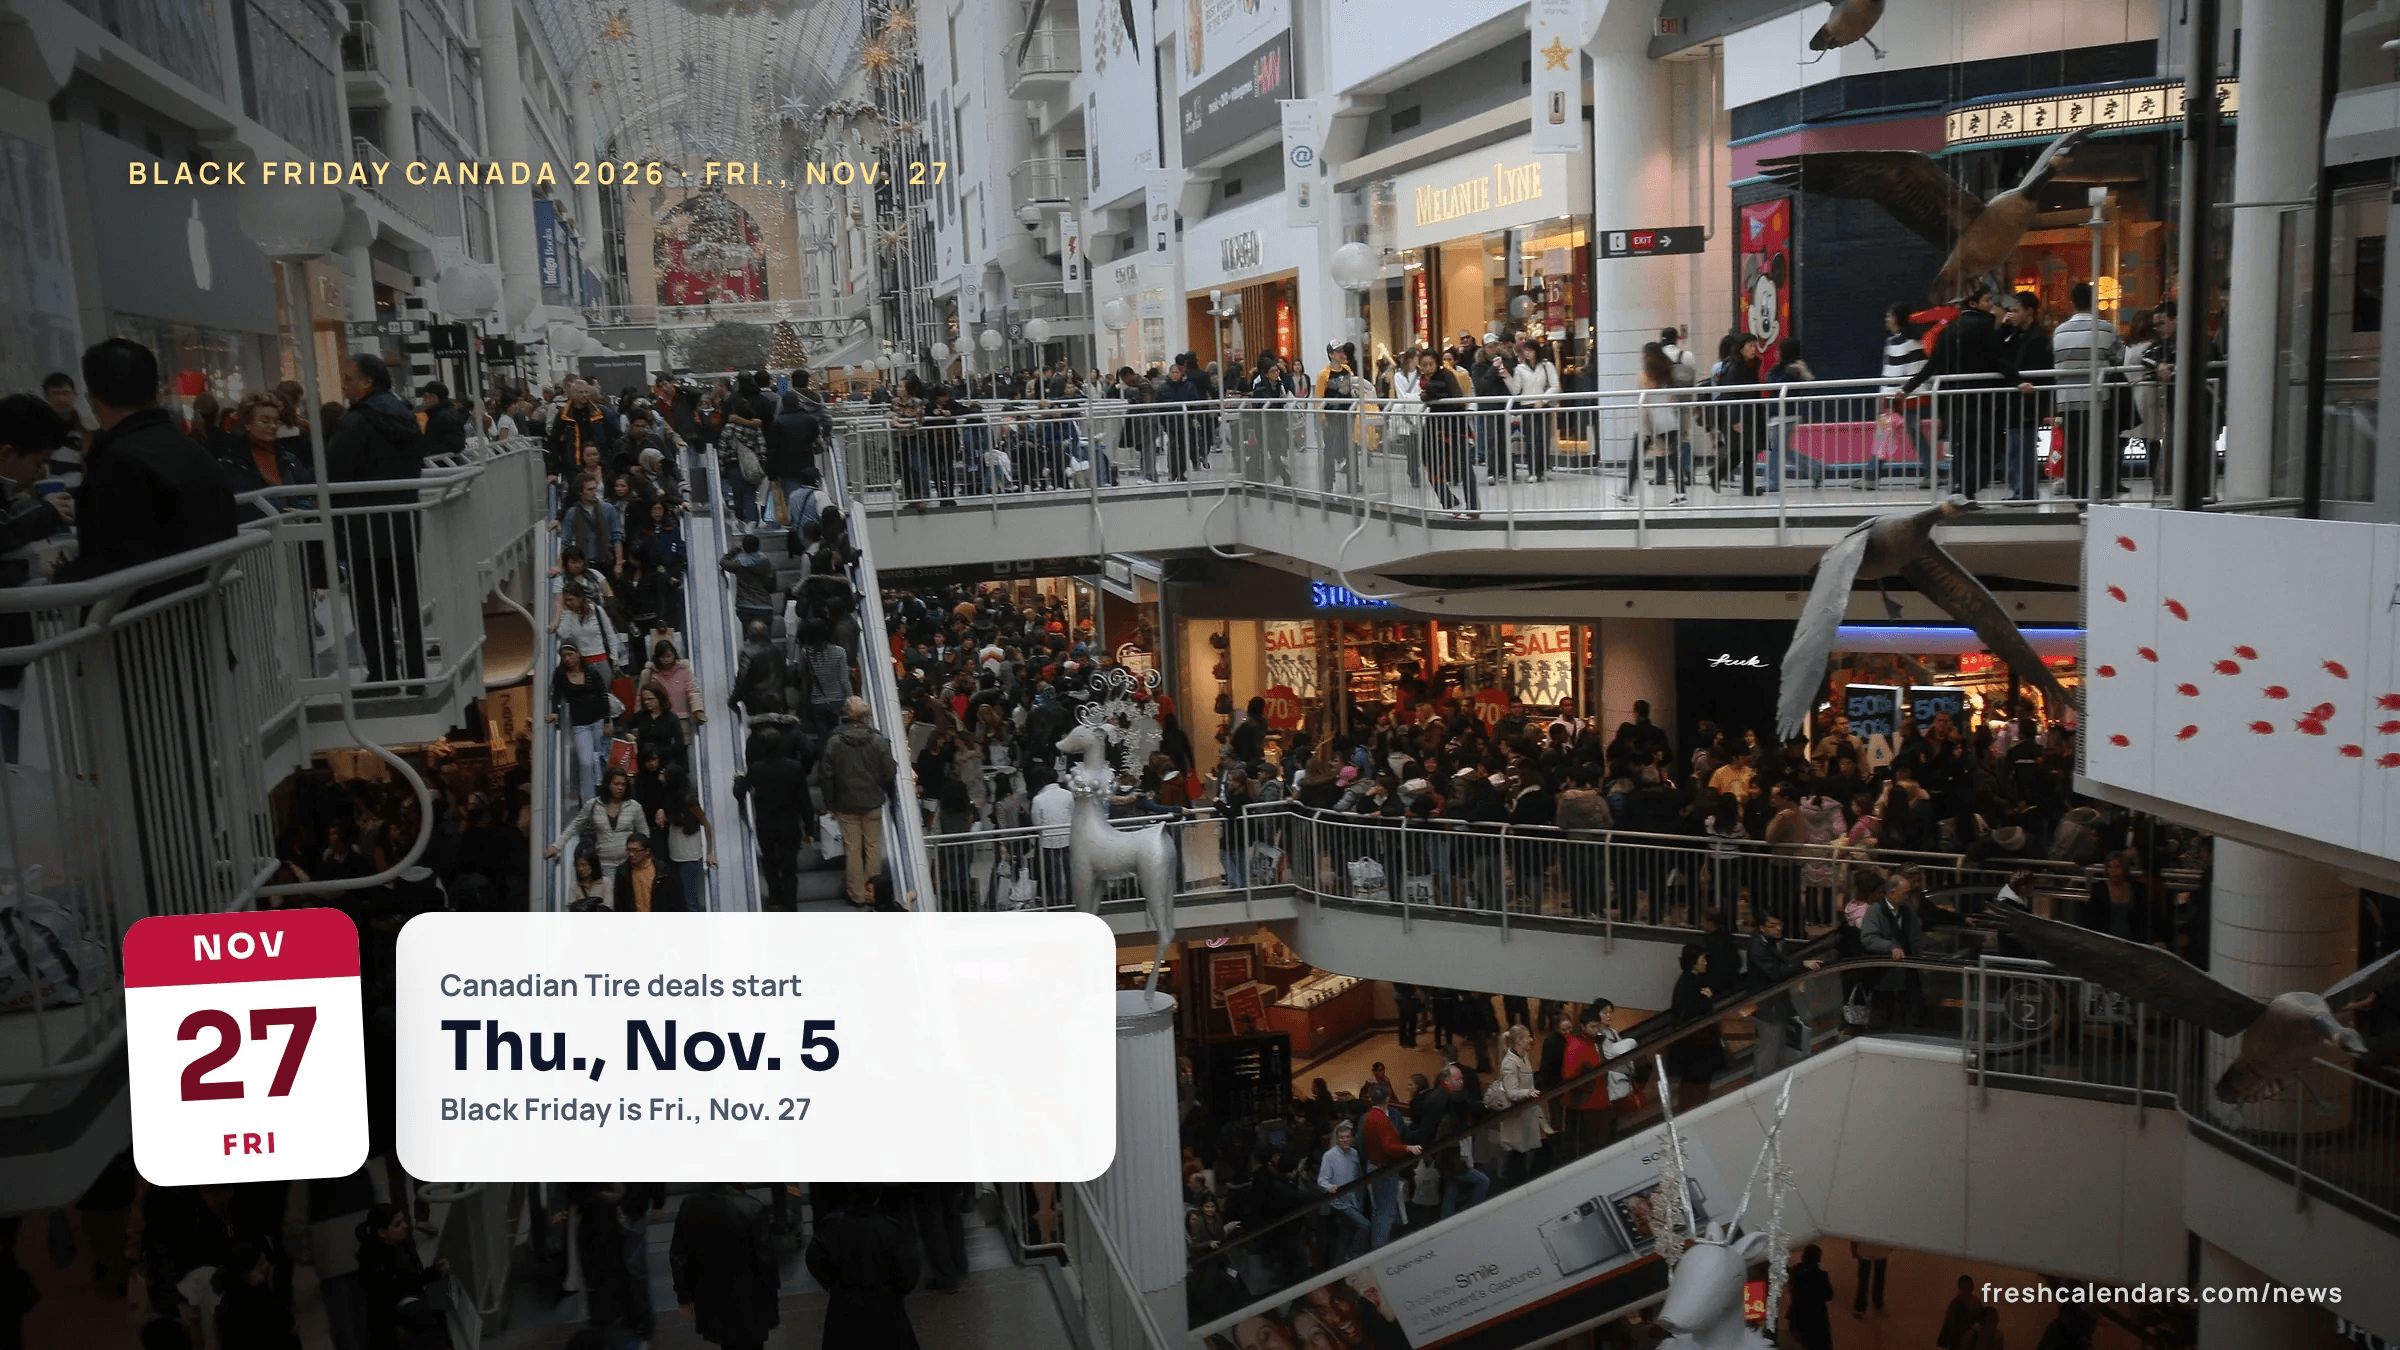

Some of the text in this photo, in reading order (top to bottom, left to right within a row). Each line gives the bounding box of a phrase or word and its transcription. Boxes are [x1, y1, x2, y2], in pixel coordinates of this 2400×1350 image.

[1415, 161, 1543, 227] MELANIE LYNE
[1633, 235, 1653, 246] EXIT
[542, 228, 558, 284] Indigo Books
[878, 569, 915, 579] undas
[1264, 627, 1319, 651] SALE
[1513, 630, 1572, 656] SALE
[2021, 1003, 2037, 1023] 2
[1454, 1262, 1500, 1289] Smile
[1430, 1290, 1486, 1318] Moment's
[1488, 1264, 1542, 1294] Captured
